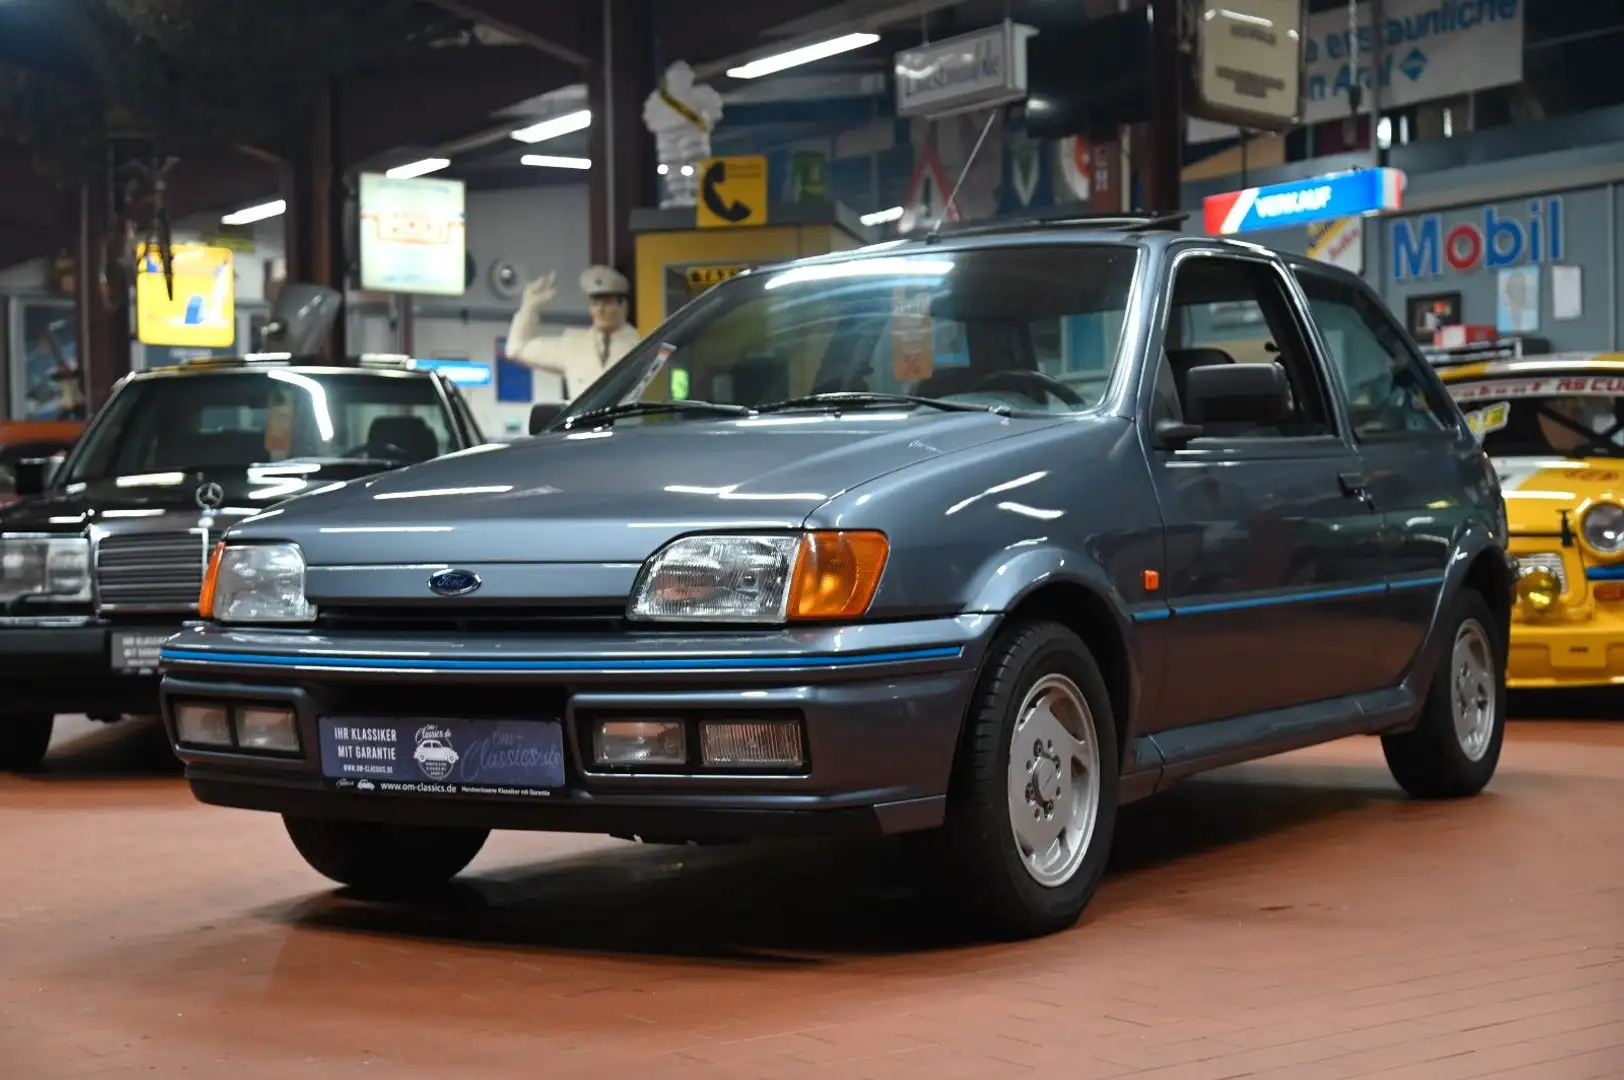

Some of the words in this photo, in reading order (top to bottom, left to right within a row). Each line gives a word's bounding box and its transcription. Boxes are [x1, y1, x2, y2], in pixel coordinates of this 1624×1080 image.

[1326, 0, 1516, 58] ersaunliche
[1391, 196, 1563, 280] Mobil
[334, 727, 349, 740] IHR
[351, 728, 397, 742] KLASSIKER
[338, 745, 353, 759] MIT
[355, 746, 397, 760] GARANTIE
[380, 781, 457, 793] www.om-classics.de
[498, 787, 520, 795] Klassiker
[529, 789, 551, 797] Garantie
